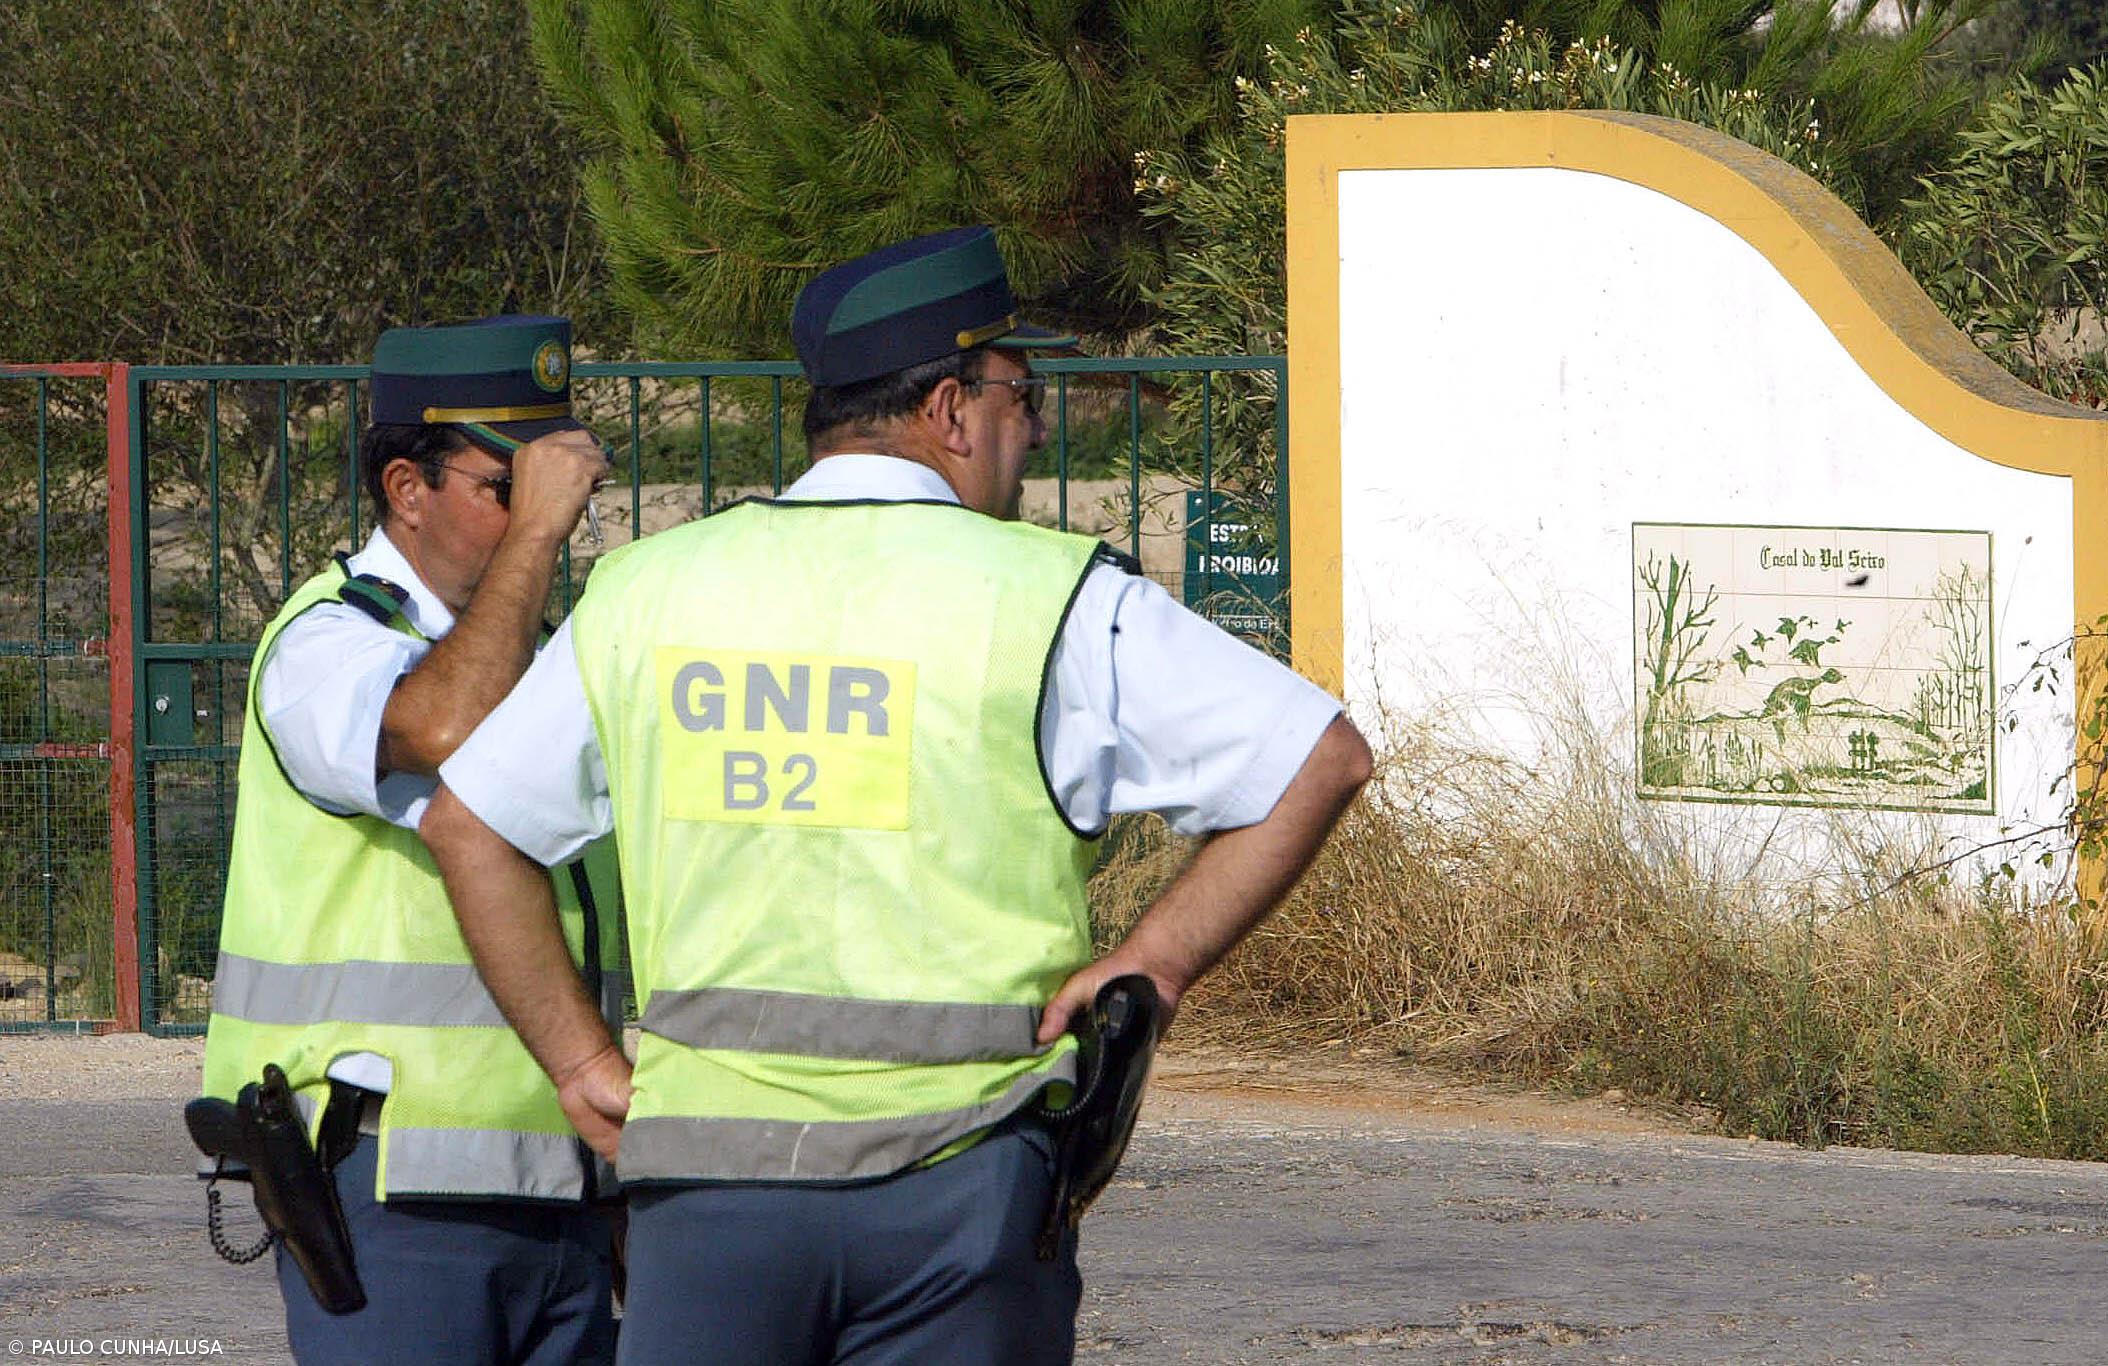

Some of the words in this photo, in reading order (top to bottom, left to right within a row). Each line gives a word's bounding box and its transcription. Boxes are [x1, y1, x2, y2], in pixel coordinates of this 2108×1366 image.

[1760, 545, 1797, 570] Casal
[1819, 548, 1843, 571] Val
[671, 660, 890, 737] GNR
[723, 750, 817, 811] B2
